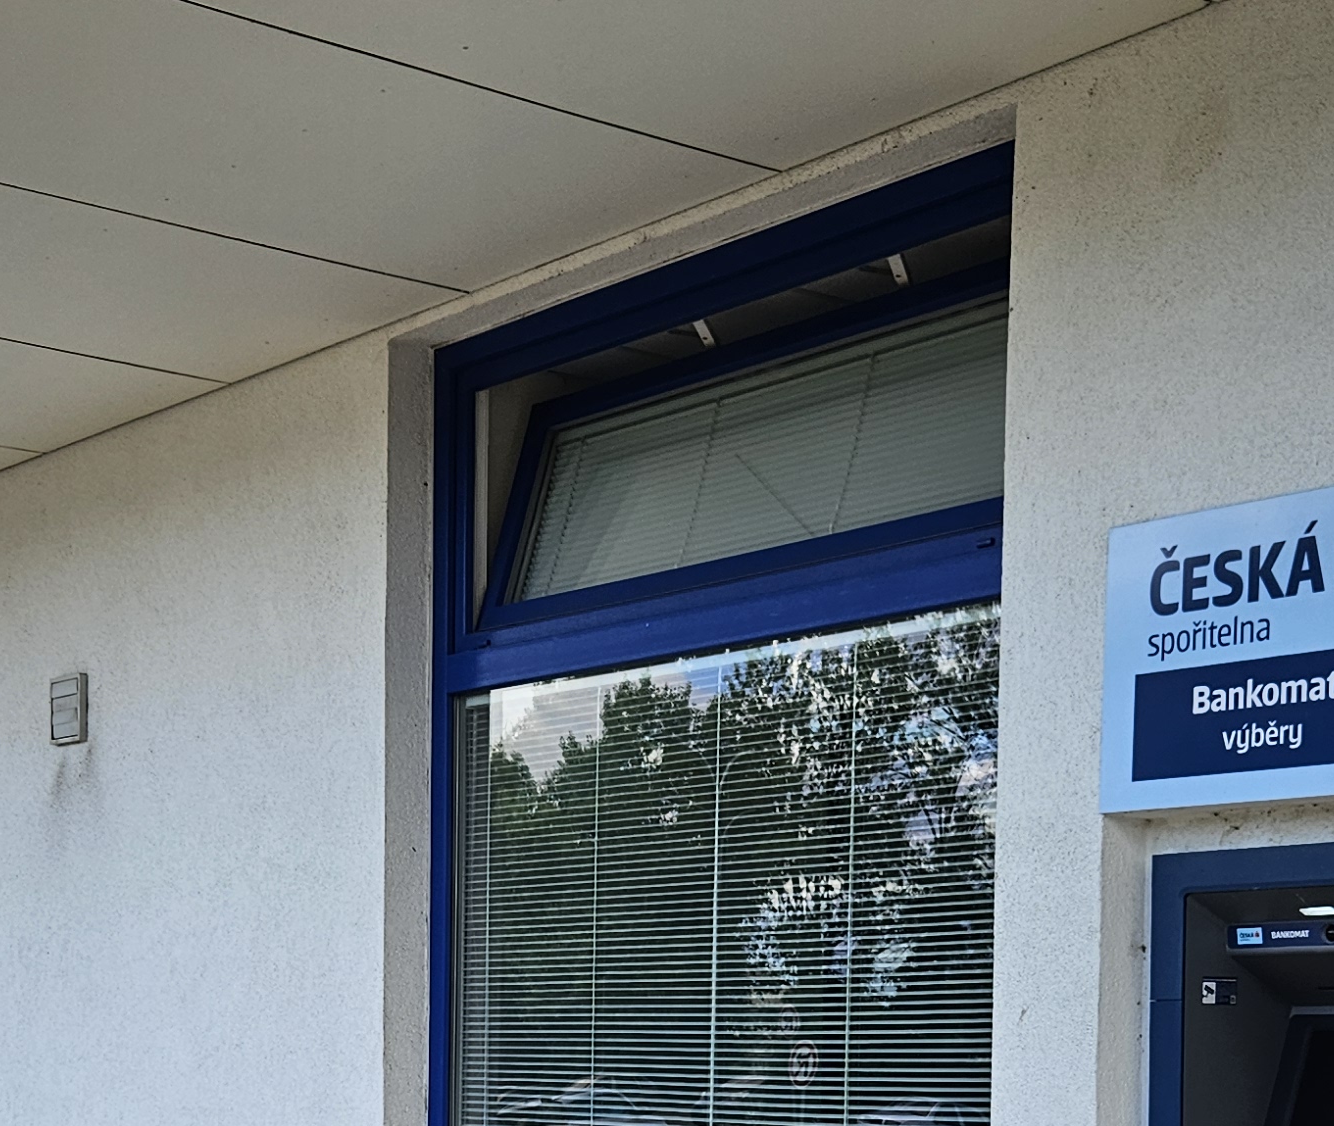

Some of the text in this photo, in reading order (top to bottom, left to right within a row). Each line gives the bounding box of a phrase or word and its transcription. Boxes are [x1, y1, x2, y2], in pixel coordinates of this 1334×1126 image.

[1149, 520, 1325, 617] ČESKÁ
[1147, 615, 1271, 661] spořitelna
[1222, 720, 1303, 754] výběry
[1270, 929, 1310, 939] BANKOMAT
